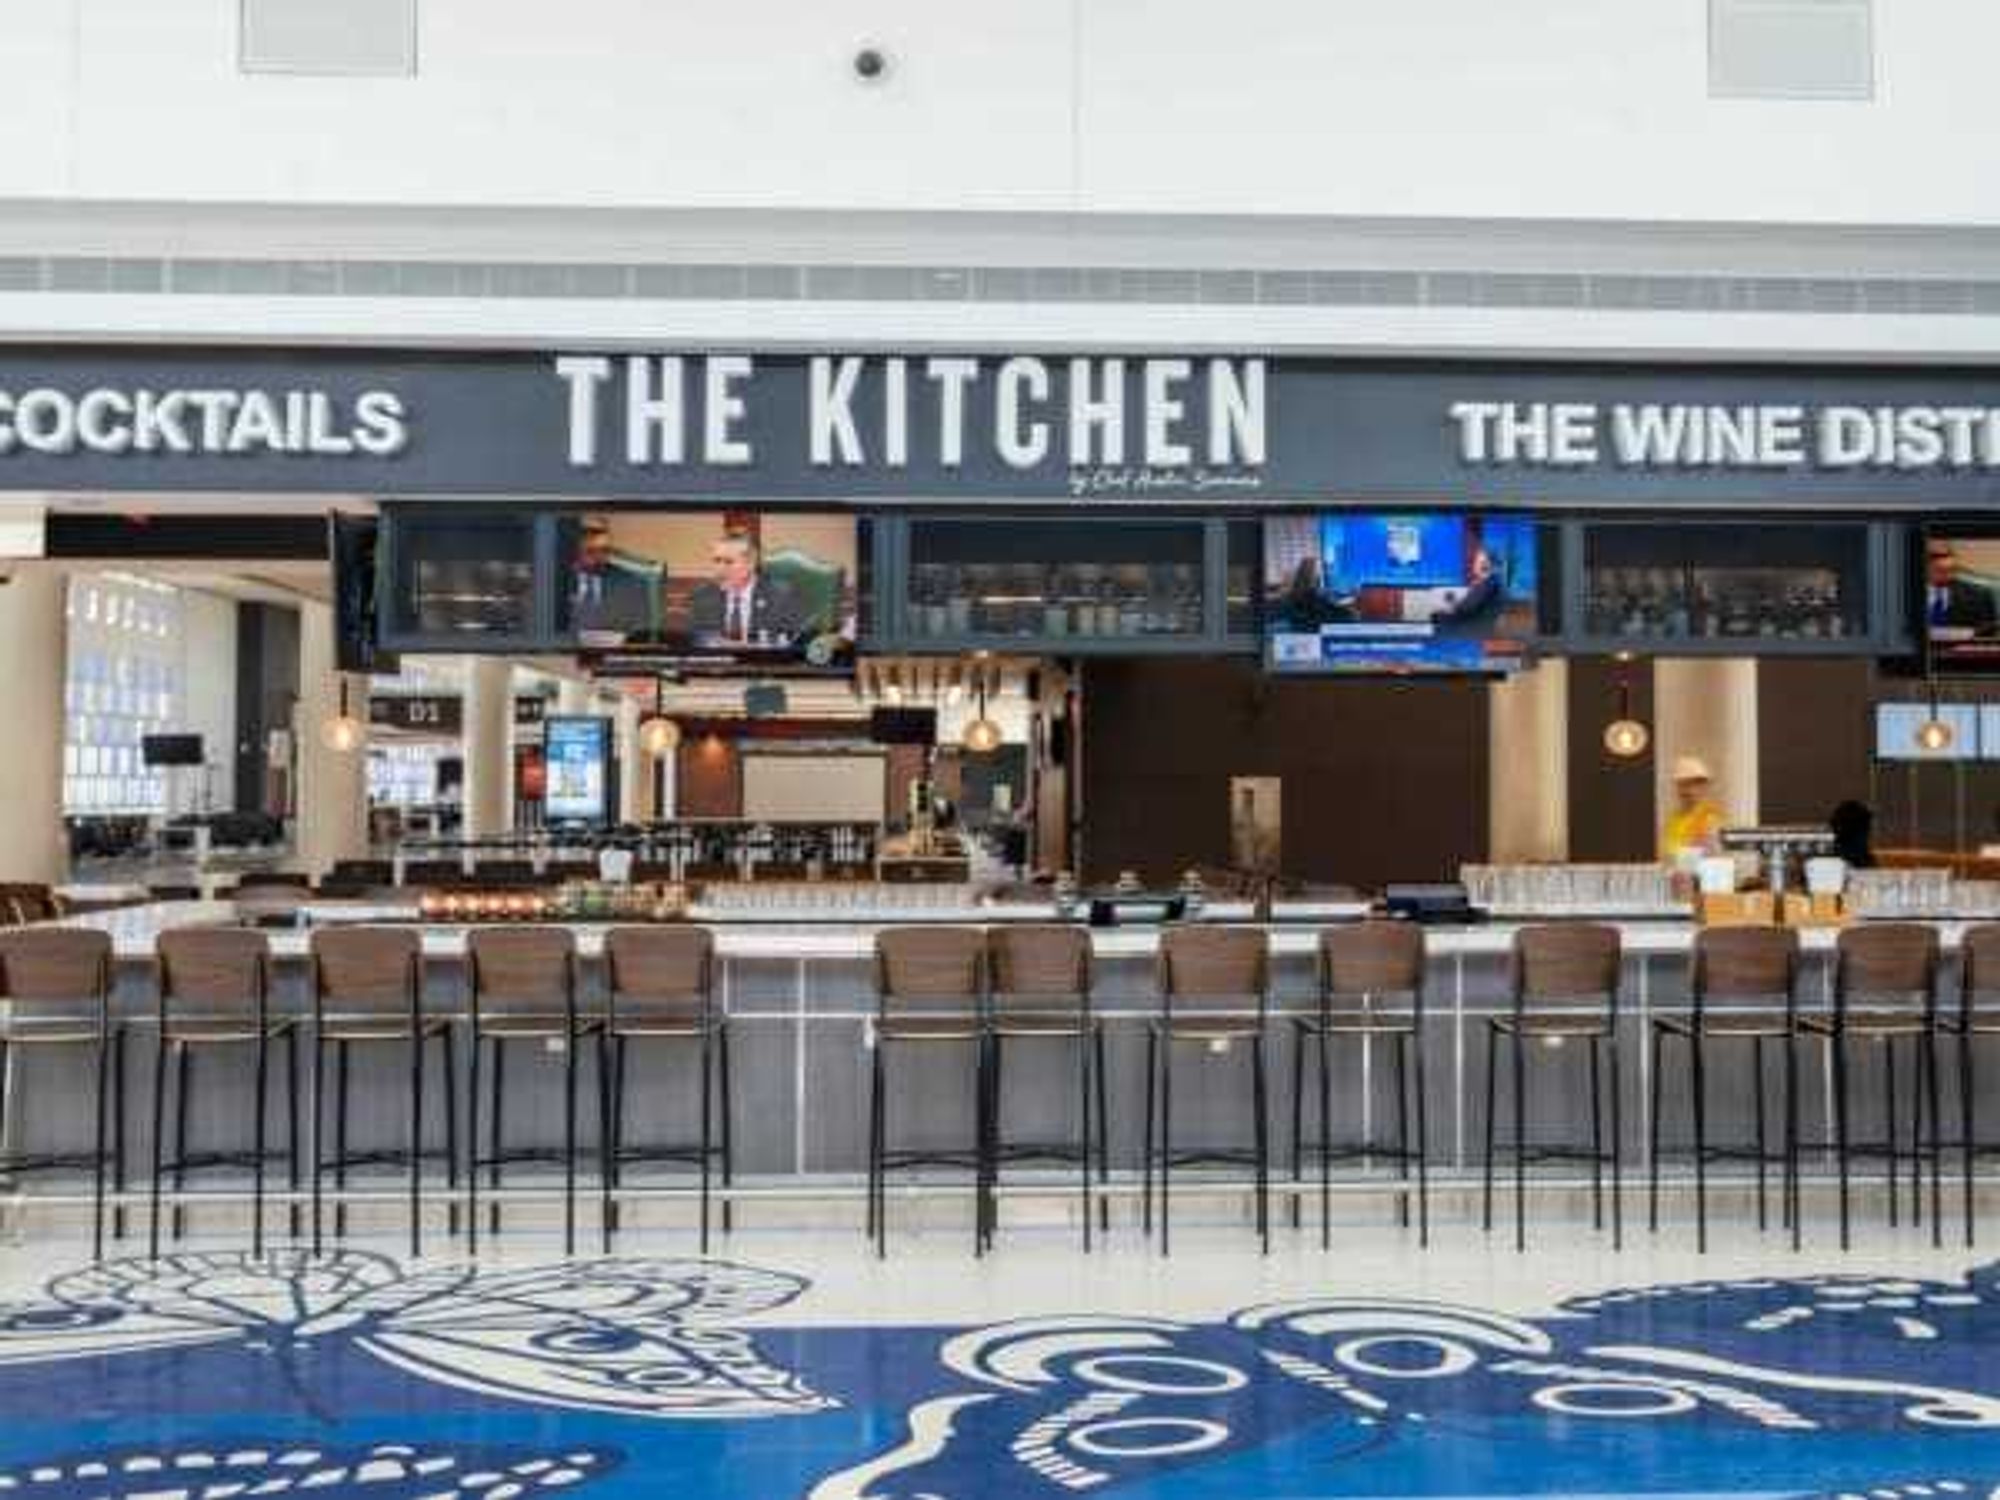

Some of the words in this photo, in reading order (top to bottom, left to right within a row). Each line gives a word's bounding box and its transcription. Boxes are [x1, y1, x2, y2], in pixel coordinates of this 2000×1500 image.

[0, 389, 404, 453] OCKTAILS
[556, 357, 752, 464] THE
[809, 356, 1265, 467] KITCHEN
[1450, 402, 1598, 464] THE
[1612, 404, 1802, 465] WINE
[1821, 405, 2000, 466] DIST
